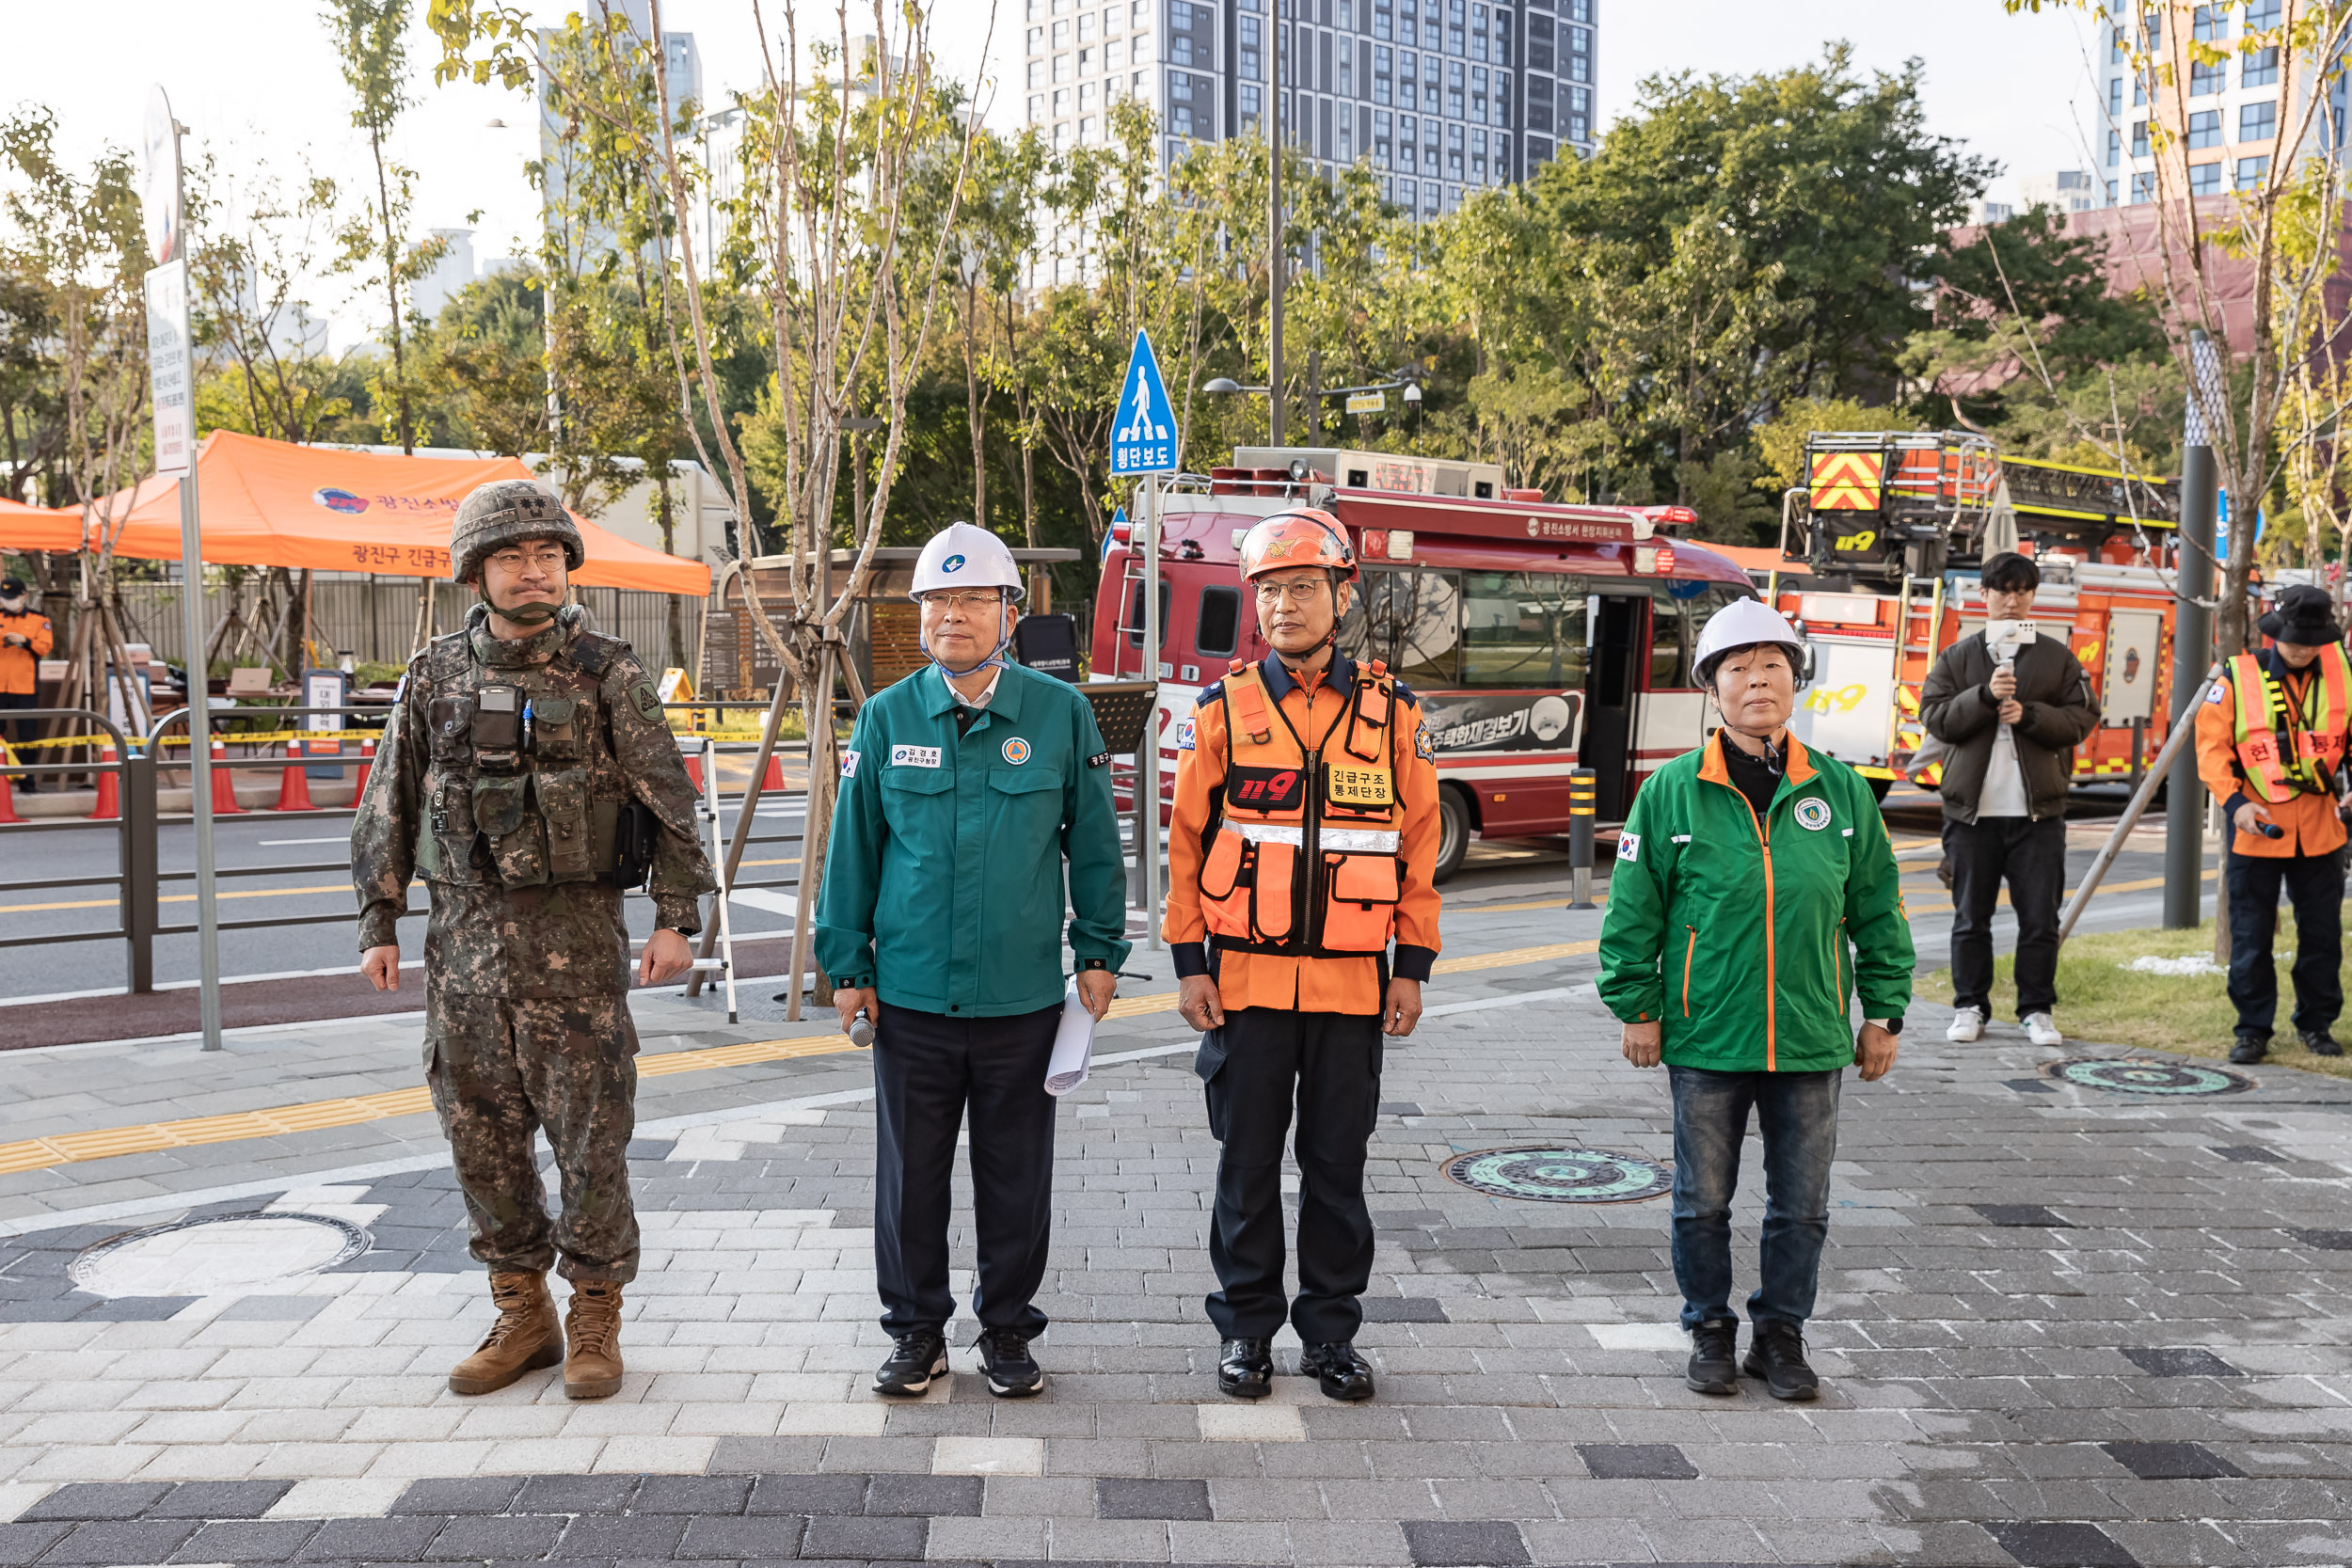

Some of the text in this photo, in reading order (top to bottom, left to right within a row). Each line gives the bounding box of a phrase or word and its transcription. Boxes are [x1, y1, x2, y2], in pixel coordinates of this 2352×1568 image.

[1117, 447, 1168, 469] 횡단보도
[1543, 522, 1580, 536] 광진소방서
[1835, 531, 1876, 551] 119
[353, 545, 401, 564] 광진구
[1803, 685, 1867, 712] 119
[1432, 708, 1530, 750] 주택화재경보기
[909, 749, 937, 758] 김경호
[1238, 771, 1296, 800] 119
[1333, 770, 1385, 784] 긴급구조
[1333, 785, 1386, 800] 통제단장
